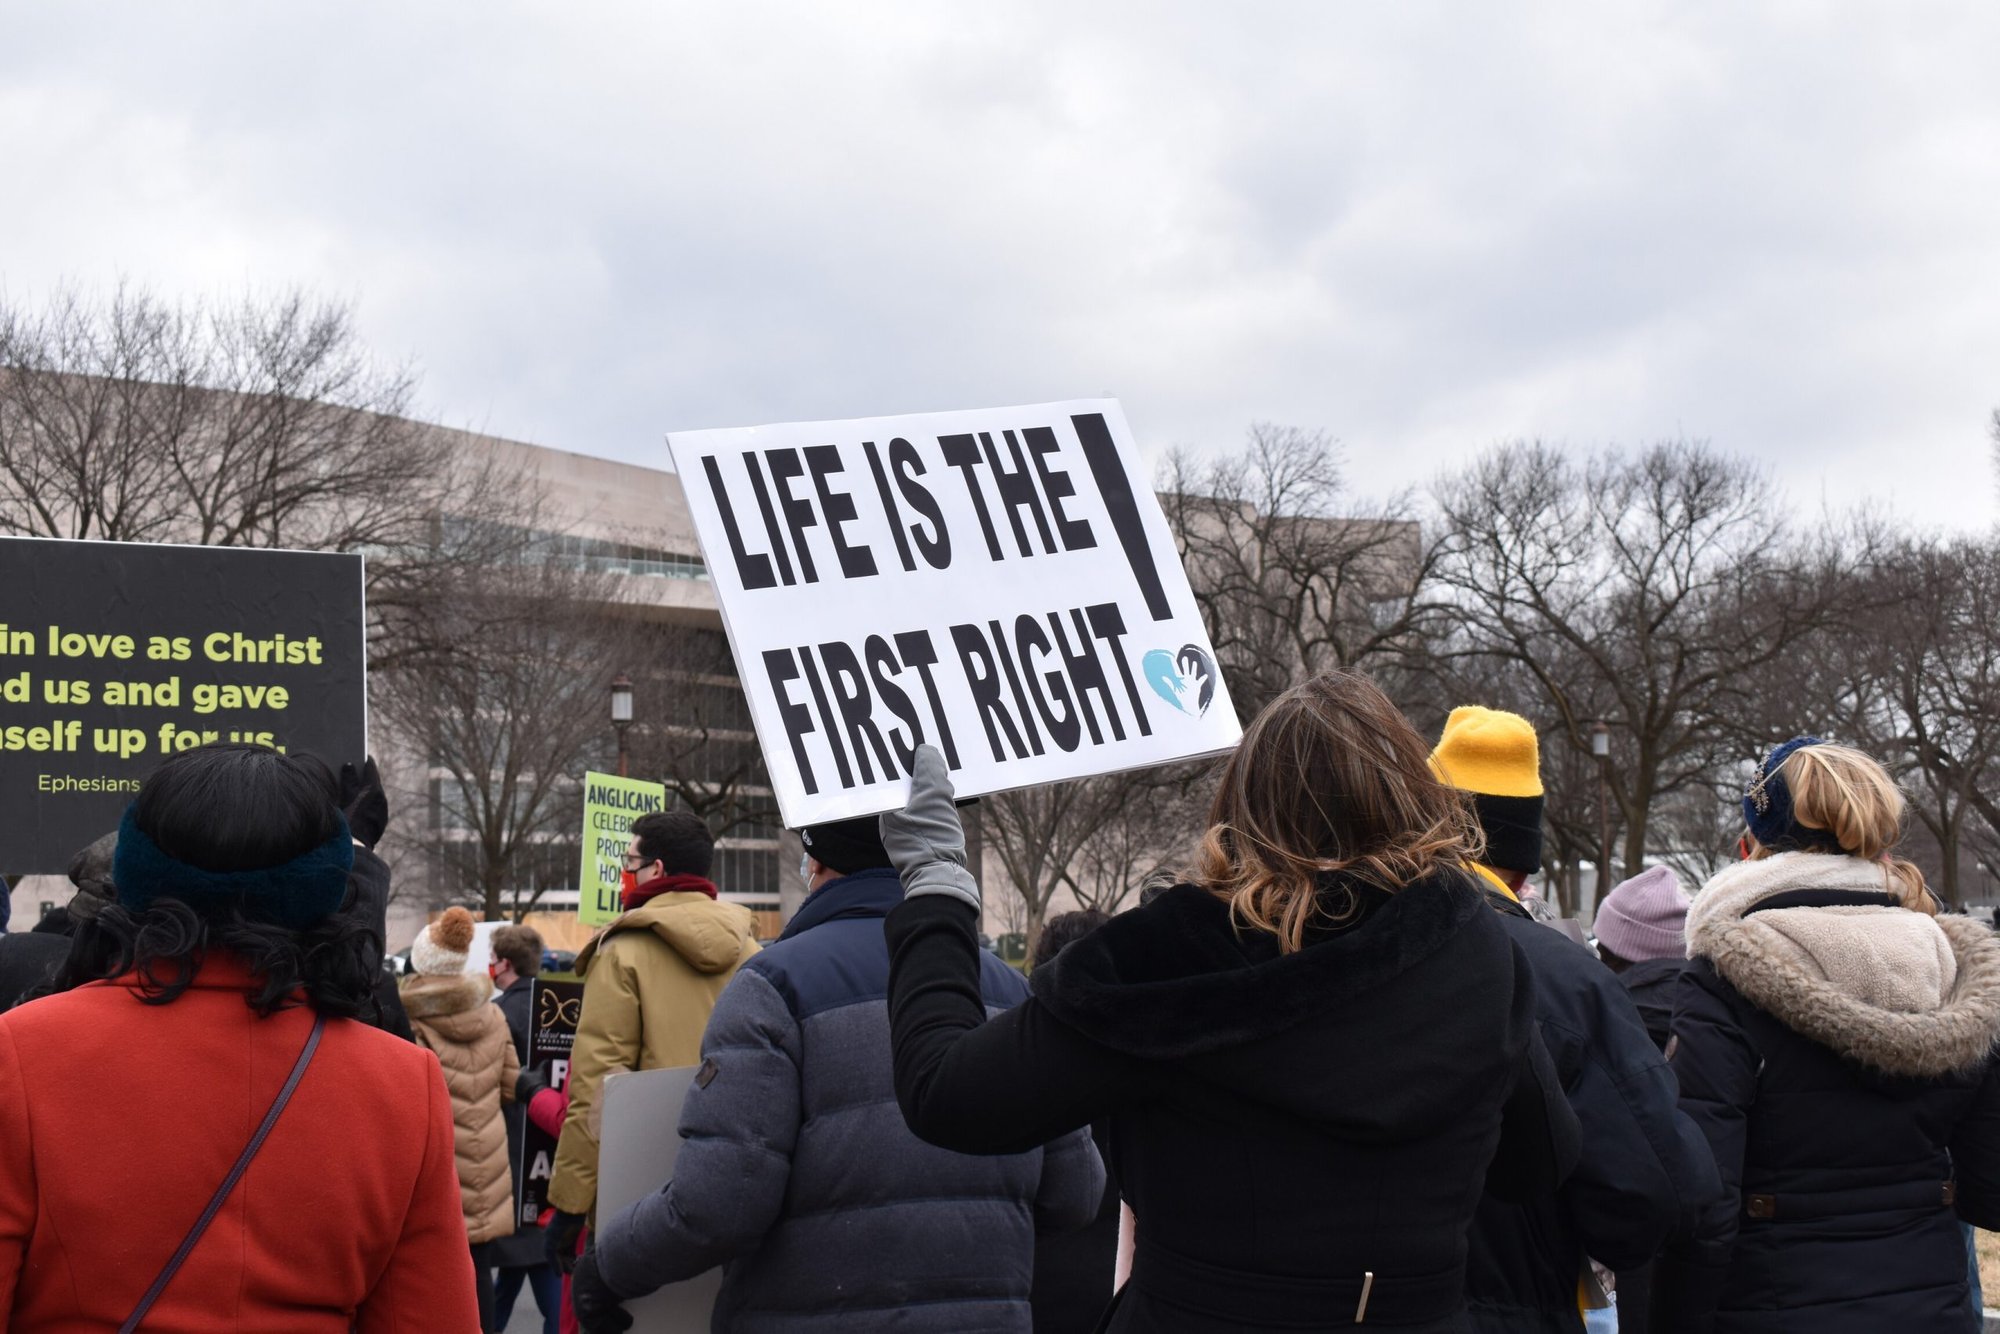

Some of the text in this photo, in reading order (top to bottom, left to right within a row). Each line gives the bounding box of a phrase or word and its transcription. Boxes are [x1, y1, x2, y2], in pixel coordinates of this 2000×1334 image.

[701, 444, 880, 591] LIFE
[862, 437, 952, 572] IS
[937, 427, 1098, 562] THE
[0, 623, 323, 665] in love as Christ
[0, 672, 289, 714] d us and gave
[762, 602, 1153, 796] FIRST RIGHT
[0, 720, 82, 752] self
[93, 728, 147, 759] up
[158, 722, 219, 753] for
[38, 774, 141, 794] Ephesians
[588, 784, 661, 812] ANGLICANS
[593, 811, 635, 834] CELEBR
[596, 838, 631, 858] PROT
